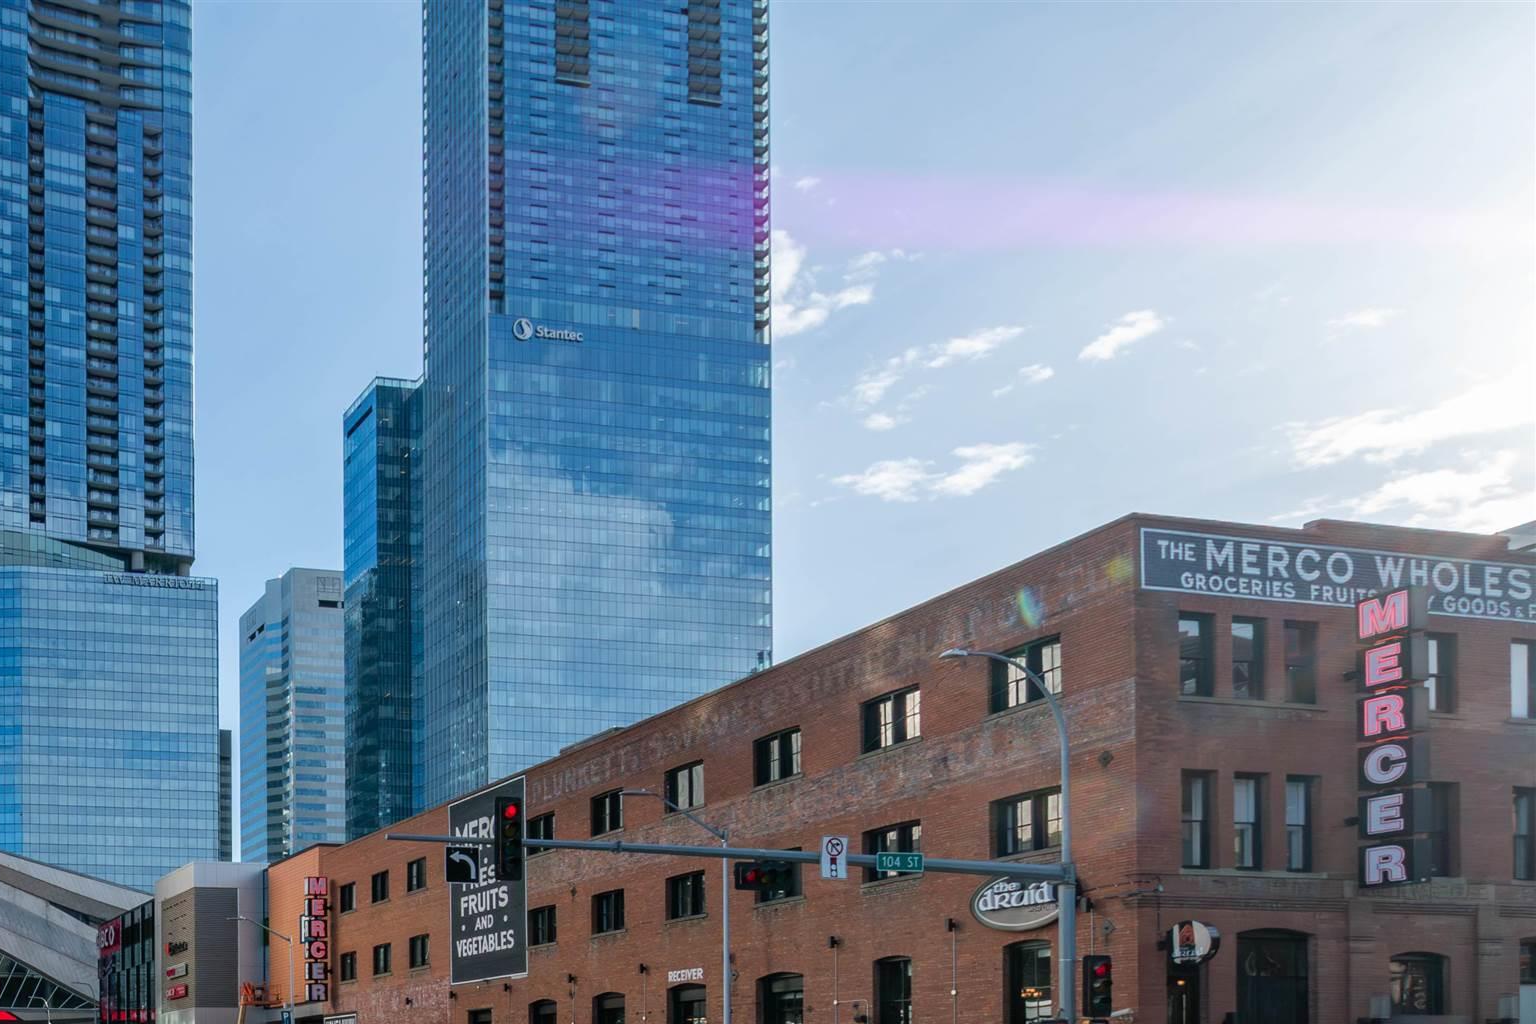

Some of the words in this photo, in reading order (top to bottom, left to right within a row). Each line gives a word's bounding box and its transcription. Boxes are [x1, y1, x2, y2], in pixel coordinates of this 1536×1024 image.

[535, 325, 584, 342] Stantec
[1157, 539, 1197, 562] THE
[1206, 539, 1354, 584] MERCO
[1374, 555, 1533, 600] WHOLES
[132, 576, 205, 590] MARRIOTT
[1180, 571, 1296, 598] GROCERIES
[1443, 595, 1511, 617] GOODS
[1359, 590, 1407, 885] MERCER
[882, 856, 900, 868] 104
[907, 856, 919, 868] ST
[993, 881, 1020, 893] the
[460, 885, 509, 917] FRUITS
[474, 914, 494, 931] AND
[309, 877, 327, 1000] MERCER
[456, 929, 515, 958] VEGETABLES
[667, 968, 704, 982] RECEIVER
